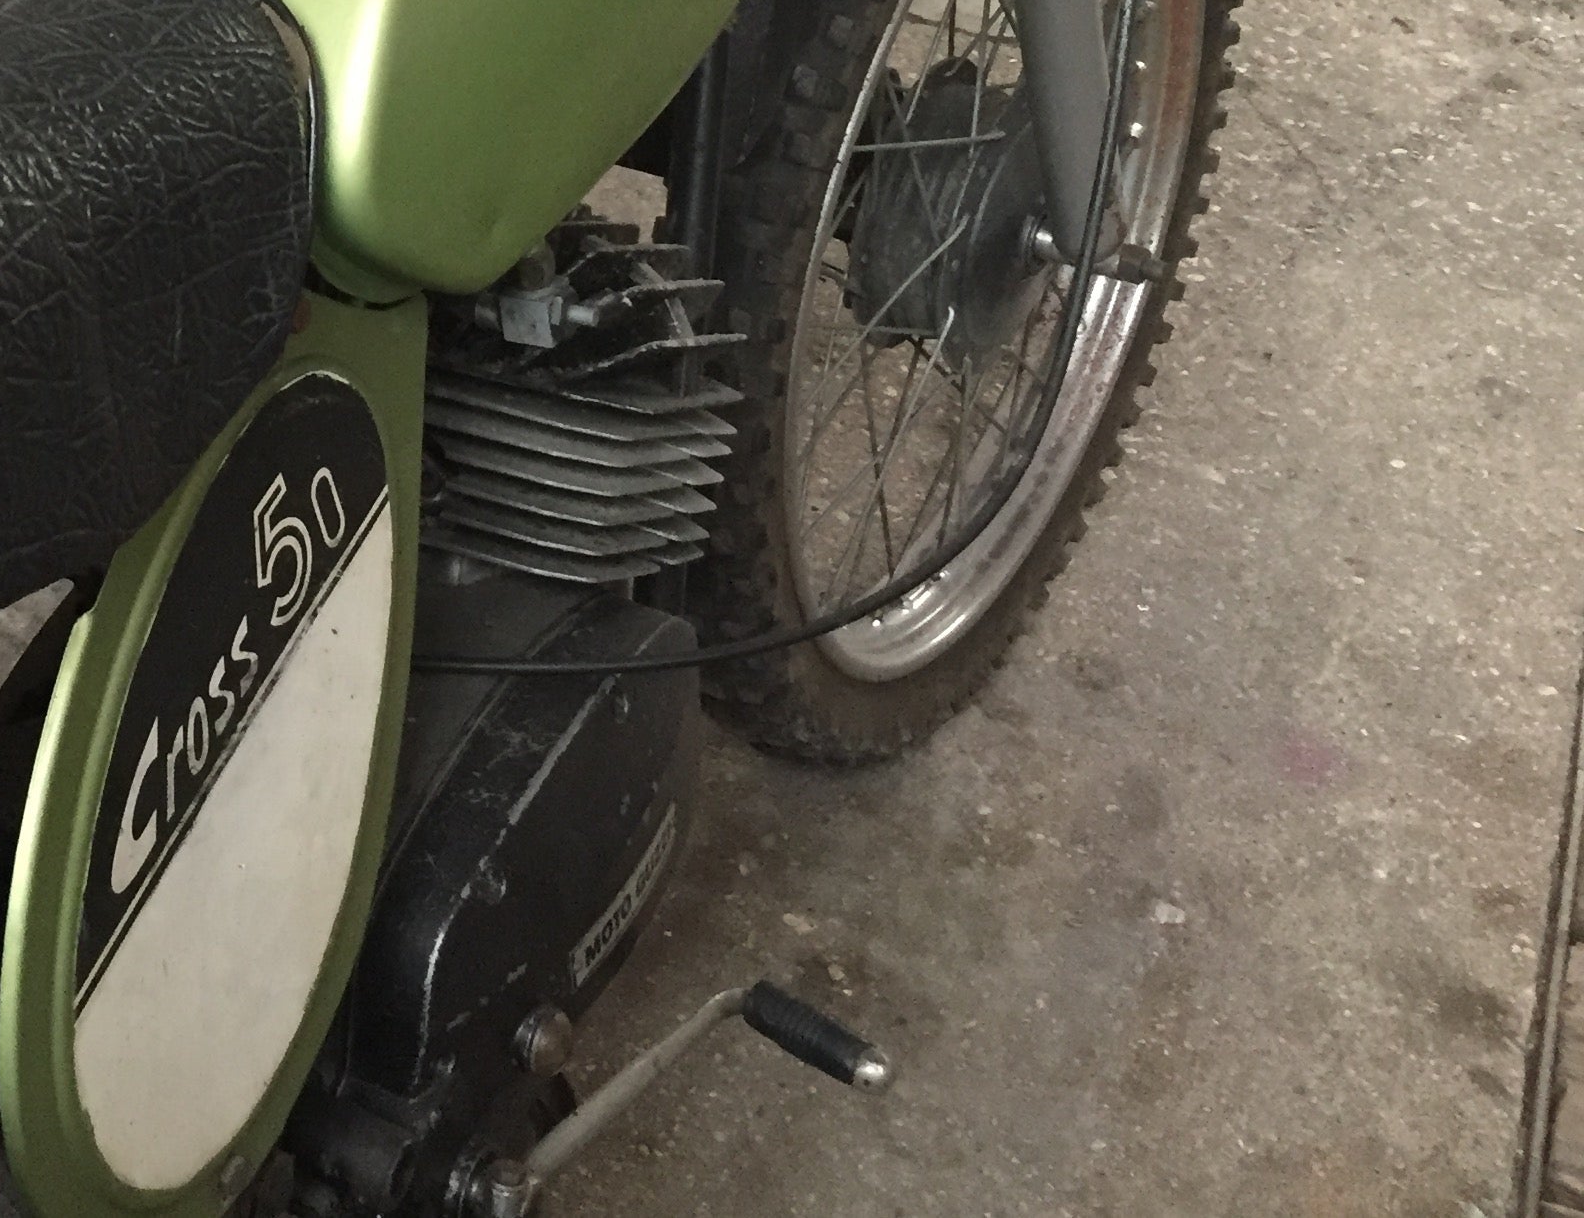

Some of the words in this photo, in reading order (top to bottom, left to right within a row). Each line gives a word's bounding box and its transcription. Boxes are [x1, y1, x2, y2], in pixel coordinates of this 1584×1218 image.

[111, 615, 258, 894] Cross
[253, 467, 346, 627] 50
[584, 893, 632, 967] MOTO
